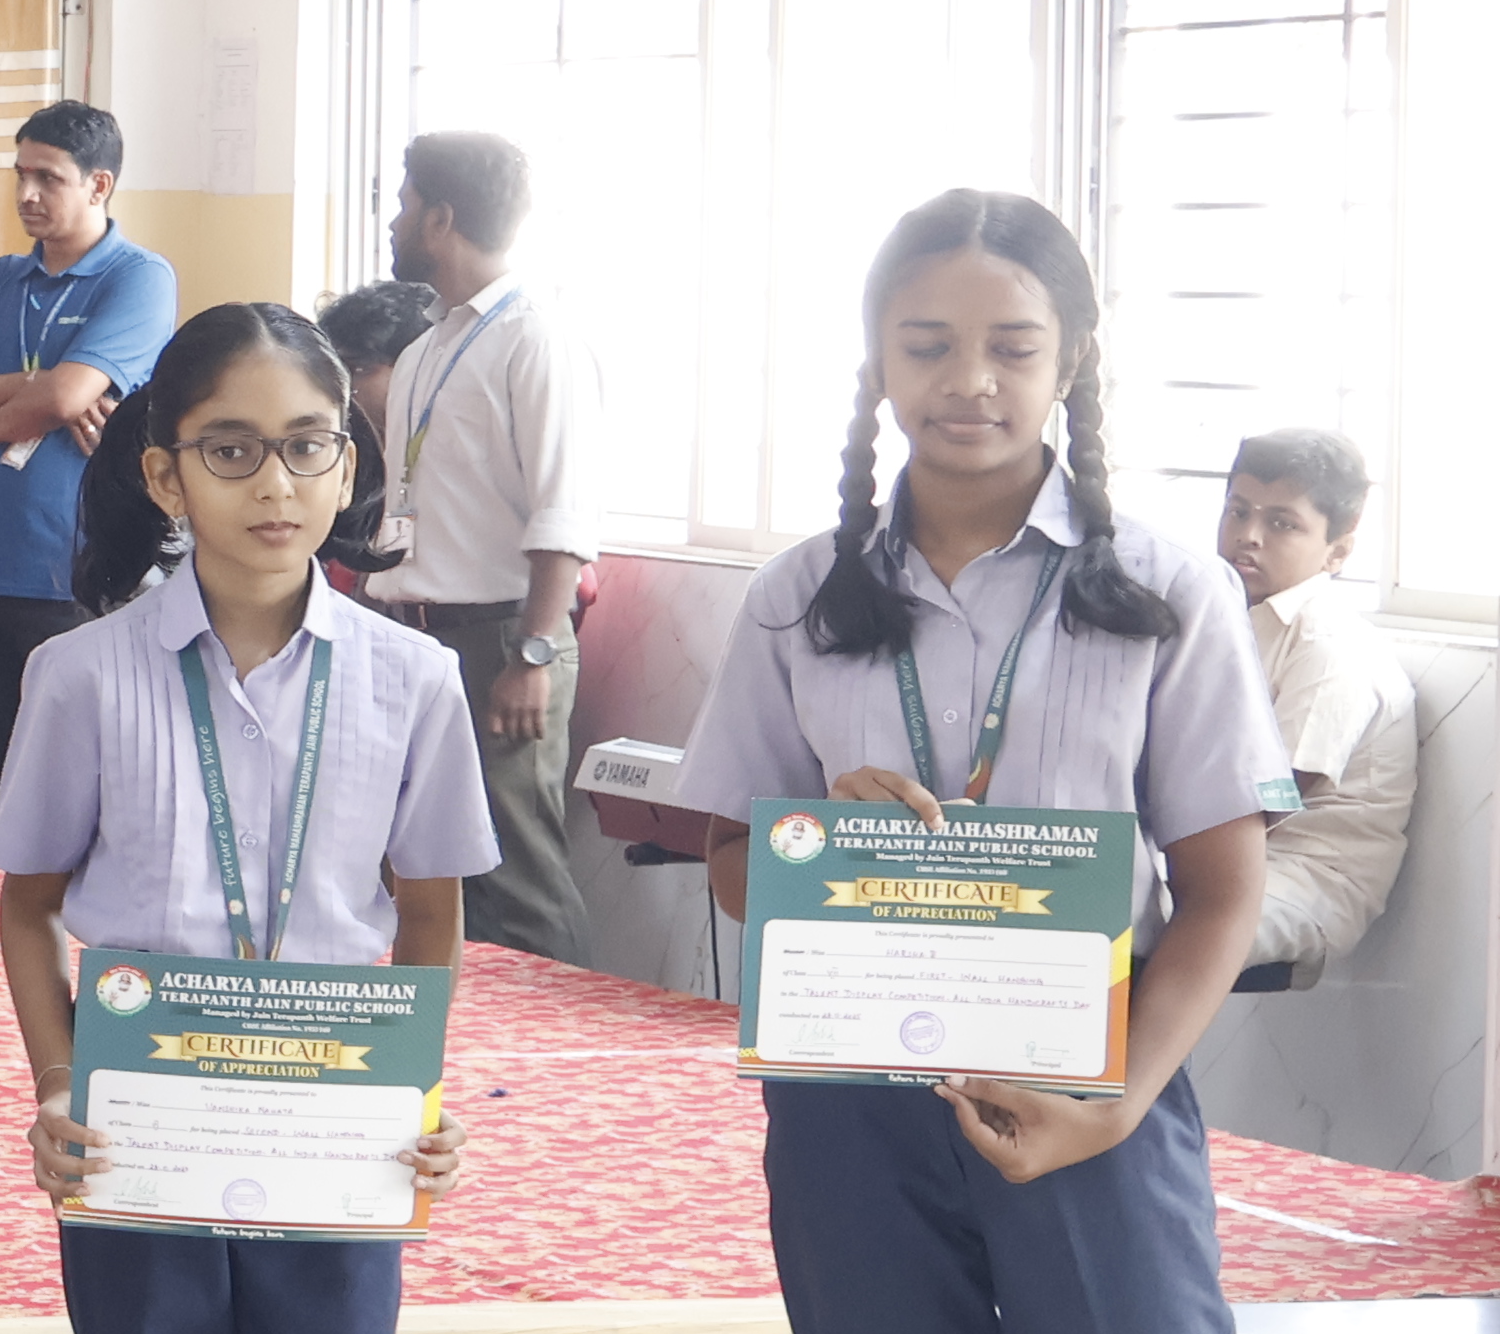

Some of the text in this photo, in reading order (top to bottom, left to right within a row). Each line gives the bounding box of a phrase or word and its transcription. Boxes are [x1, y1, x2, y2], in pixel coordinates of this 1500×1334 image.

[311, 679, 326, 707] SCHOOL
[307, 708, 322, 733] PUBLIC
[305, 734, 318, 750] JAIN
[298, 752, 315, 793] TERAPANTH
[607, 761, 651, 788] YAMAHA
[198, 725, 237, 886] future begins here
[833, 818, 929, 836] ACHARYA
[284, 850, 299, 883] ACHARYA
[861, 880, 1013, 902] CERTIFICATE
[160, 972, 416, 1000] ACHARYA MAHASHRAMAN
[186, 1035, 335, 1060] CERTIFICATE
